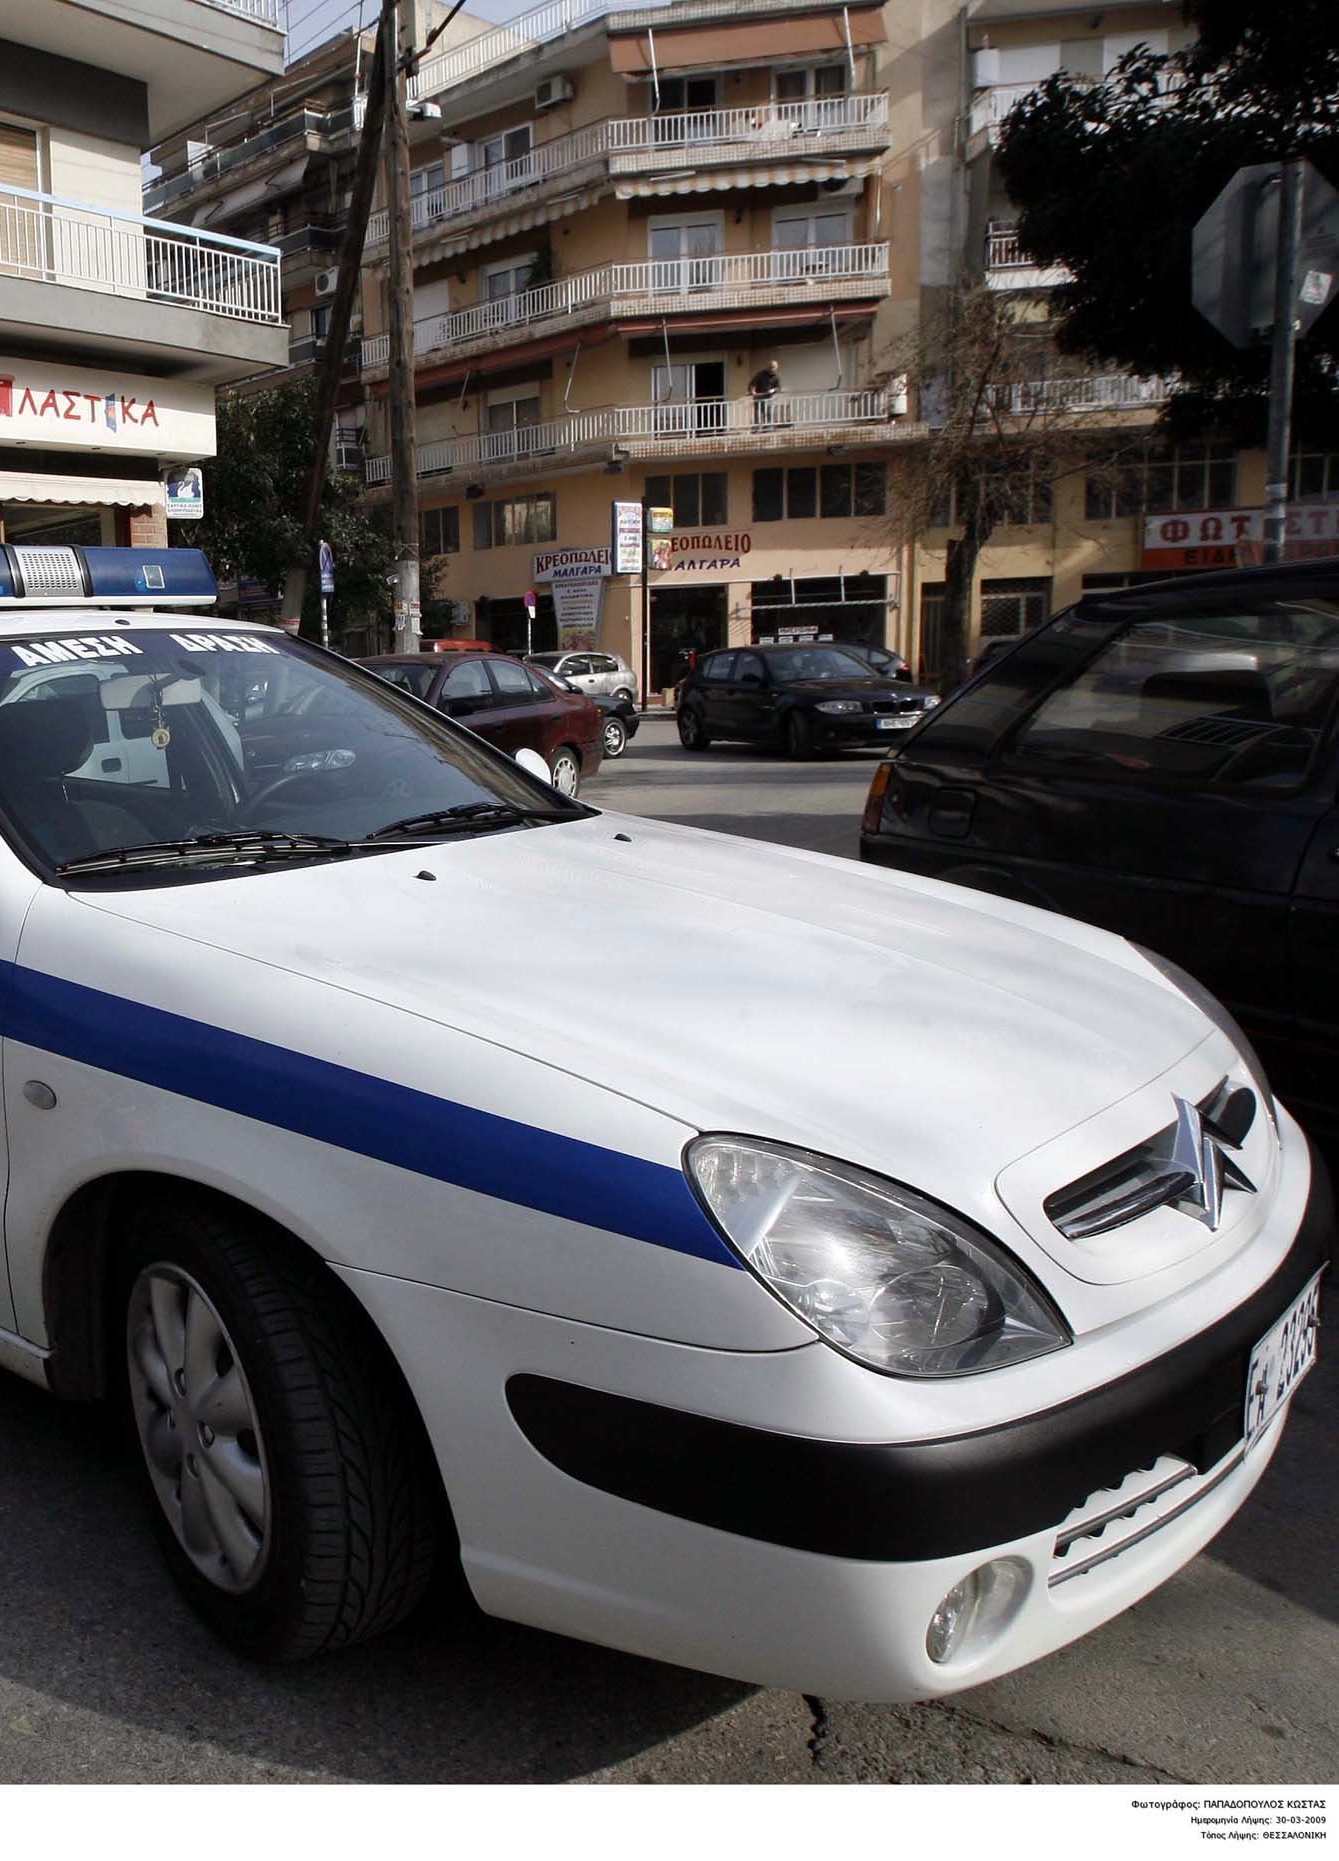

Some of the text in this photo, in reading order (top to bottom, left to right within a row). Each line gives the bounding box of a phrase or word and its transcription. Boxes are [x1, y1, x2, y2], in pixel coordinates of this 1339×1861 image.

[671, 533, 751, 553] ΕΟΠΩΛΕΙΟ
[536, 549, 612, 575] ΚΡΕΟΠΩΛΕΙ
[674, 558, 740, 571] ΑΛΓΑΡΑ
[11, 633, 281, 667] ΑΜΕΣΗ ΔΡΑΣΗ
